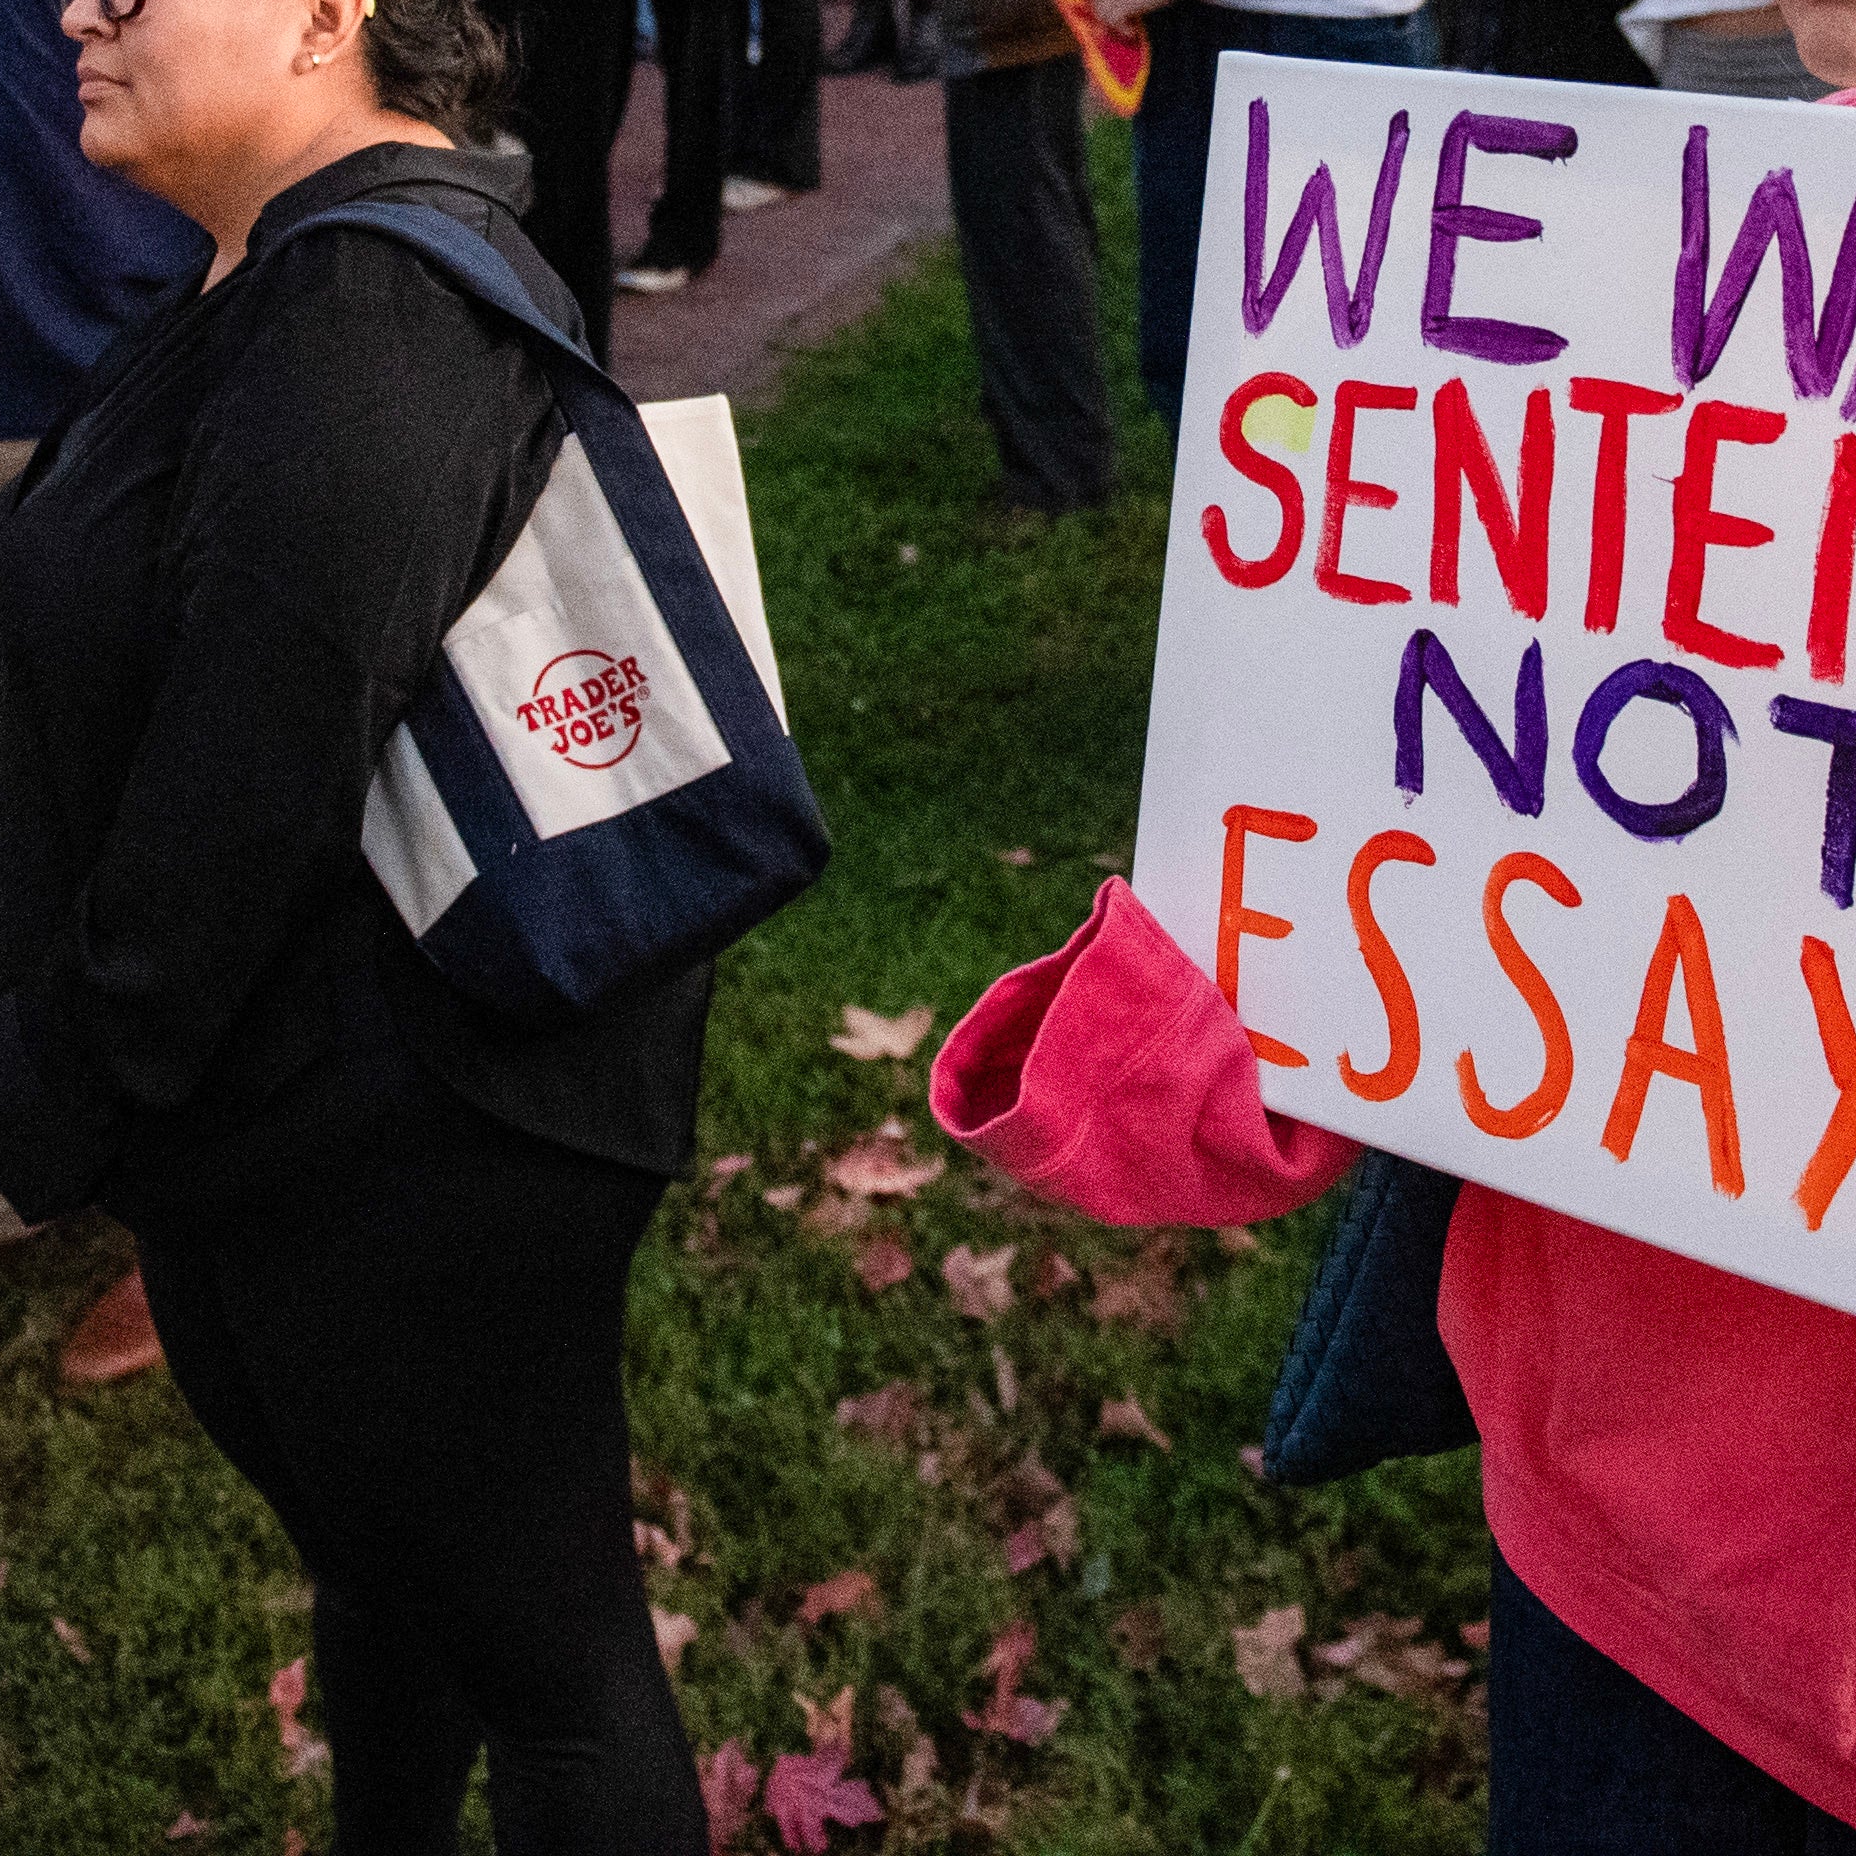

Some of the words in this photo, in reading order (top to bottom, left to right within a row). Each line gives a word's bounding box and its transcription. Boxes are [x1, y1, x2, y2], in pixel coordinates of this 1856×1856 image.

[1240, 95, 1580, 367] WE
[516, 655, 648, 733] TRADER
[550, 692, 643, 756] JOE'S
